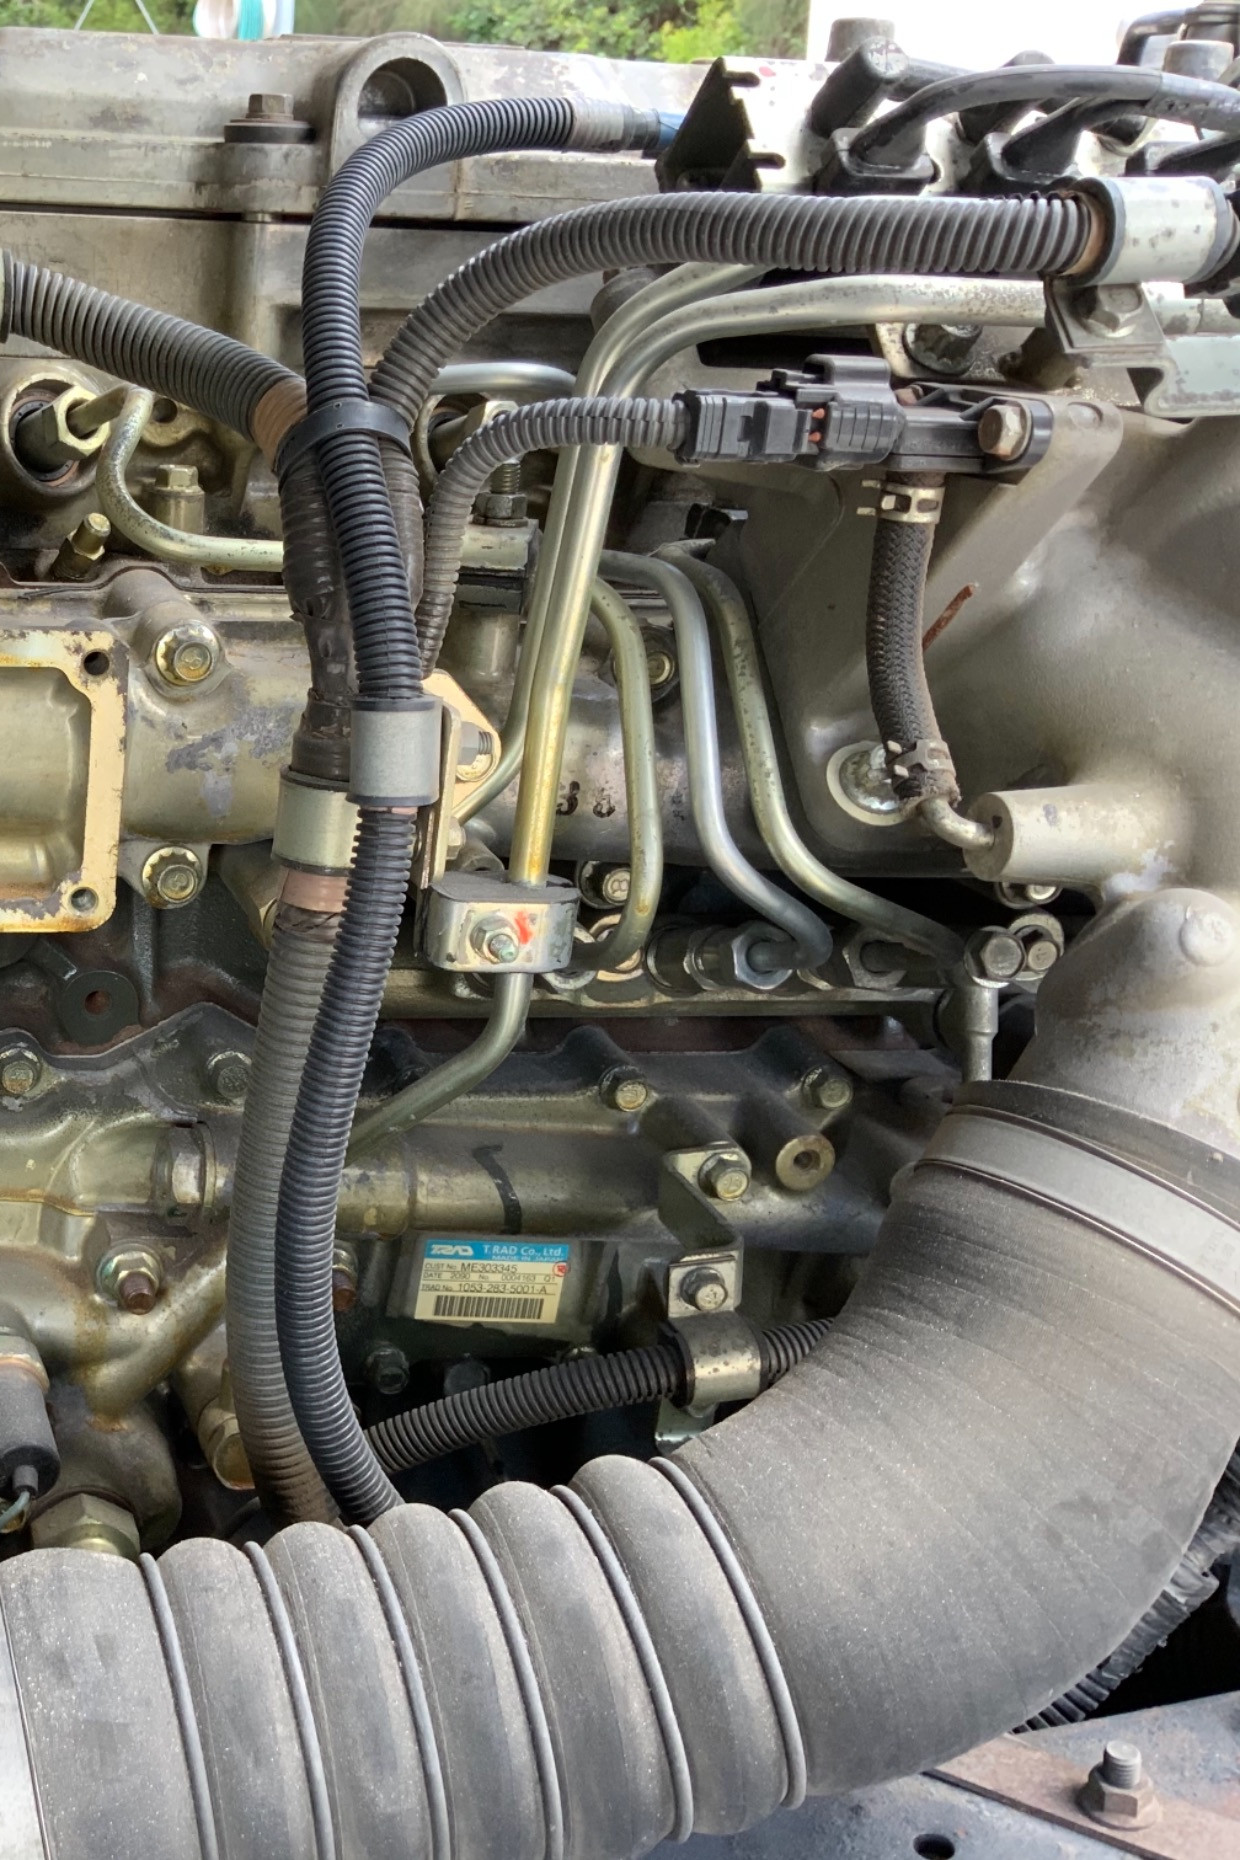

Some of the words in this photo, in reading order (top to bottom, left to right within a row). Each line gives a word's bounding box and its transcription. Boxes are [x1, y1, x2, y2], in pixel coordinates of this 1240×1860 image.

[483, 1245, 517, 1255] T.RAD
[543, 1247, 564, 1257] Ltd.
[461, 1263, 518, 1274] ME303345
